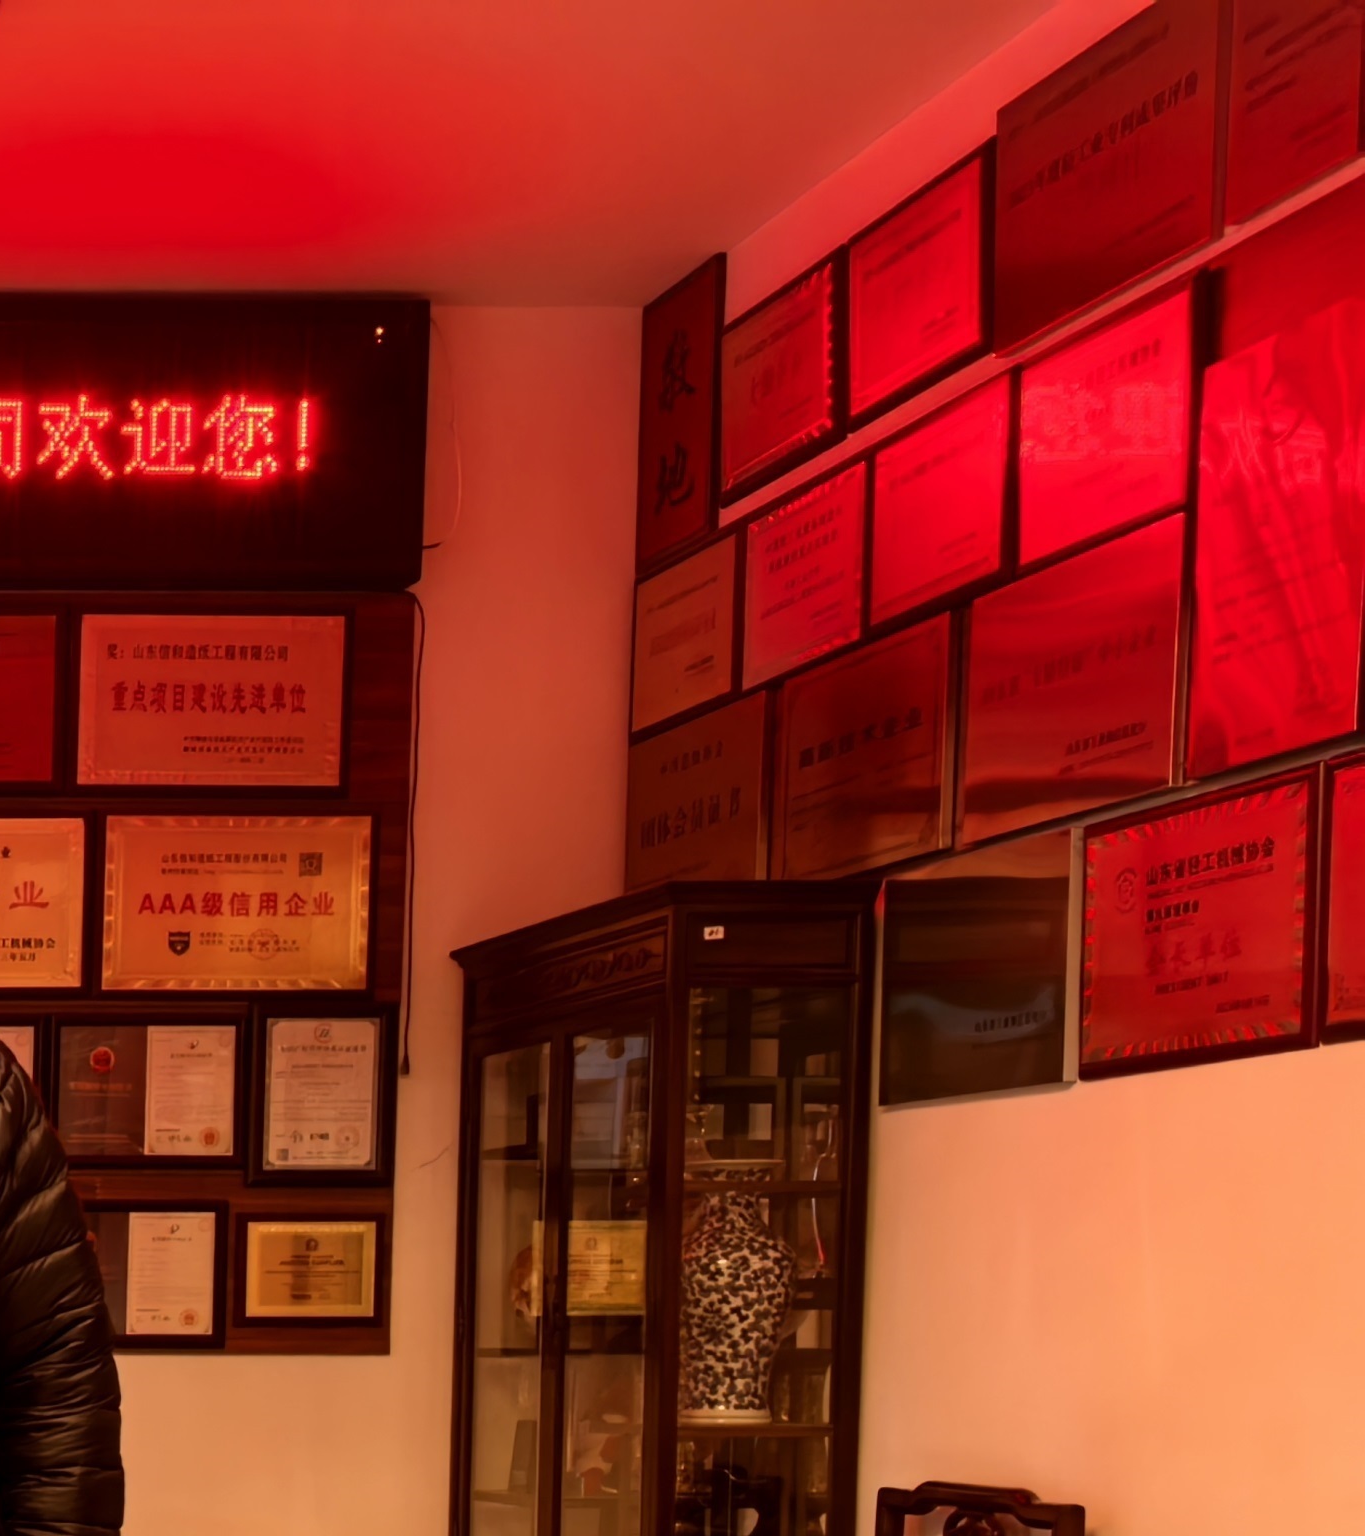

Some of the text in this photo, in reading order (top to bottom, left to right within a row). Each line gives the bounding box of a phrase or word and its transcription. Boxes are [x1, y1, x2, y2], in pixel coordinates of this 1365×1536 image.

[110, 680, 307, 715] 重点项目建设先进单位
[137, 890, 336, 918] AAA级信用企业
